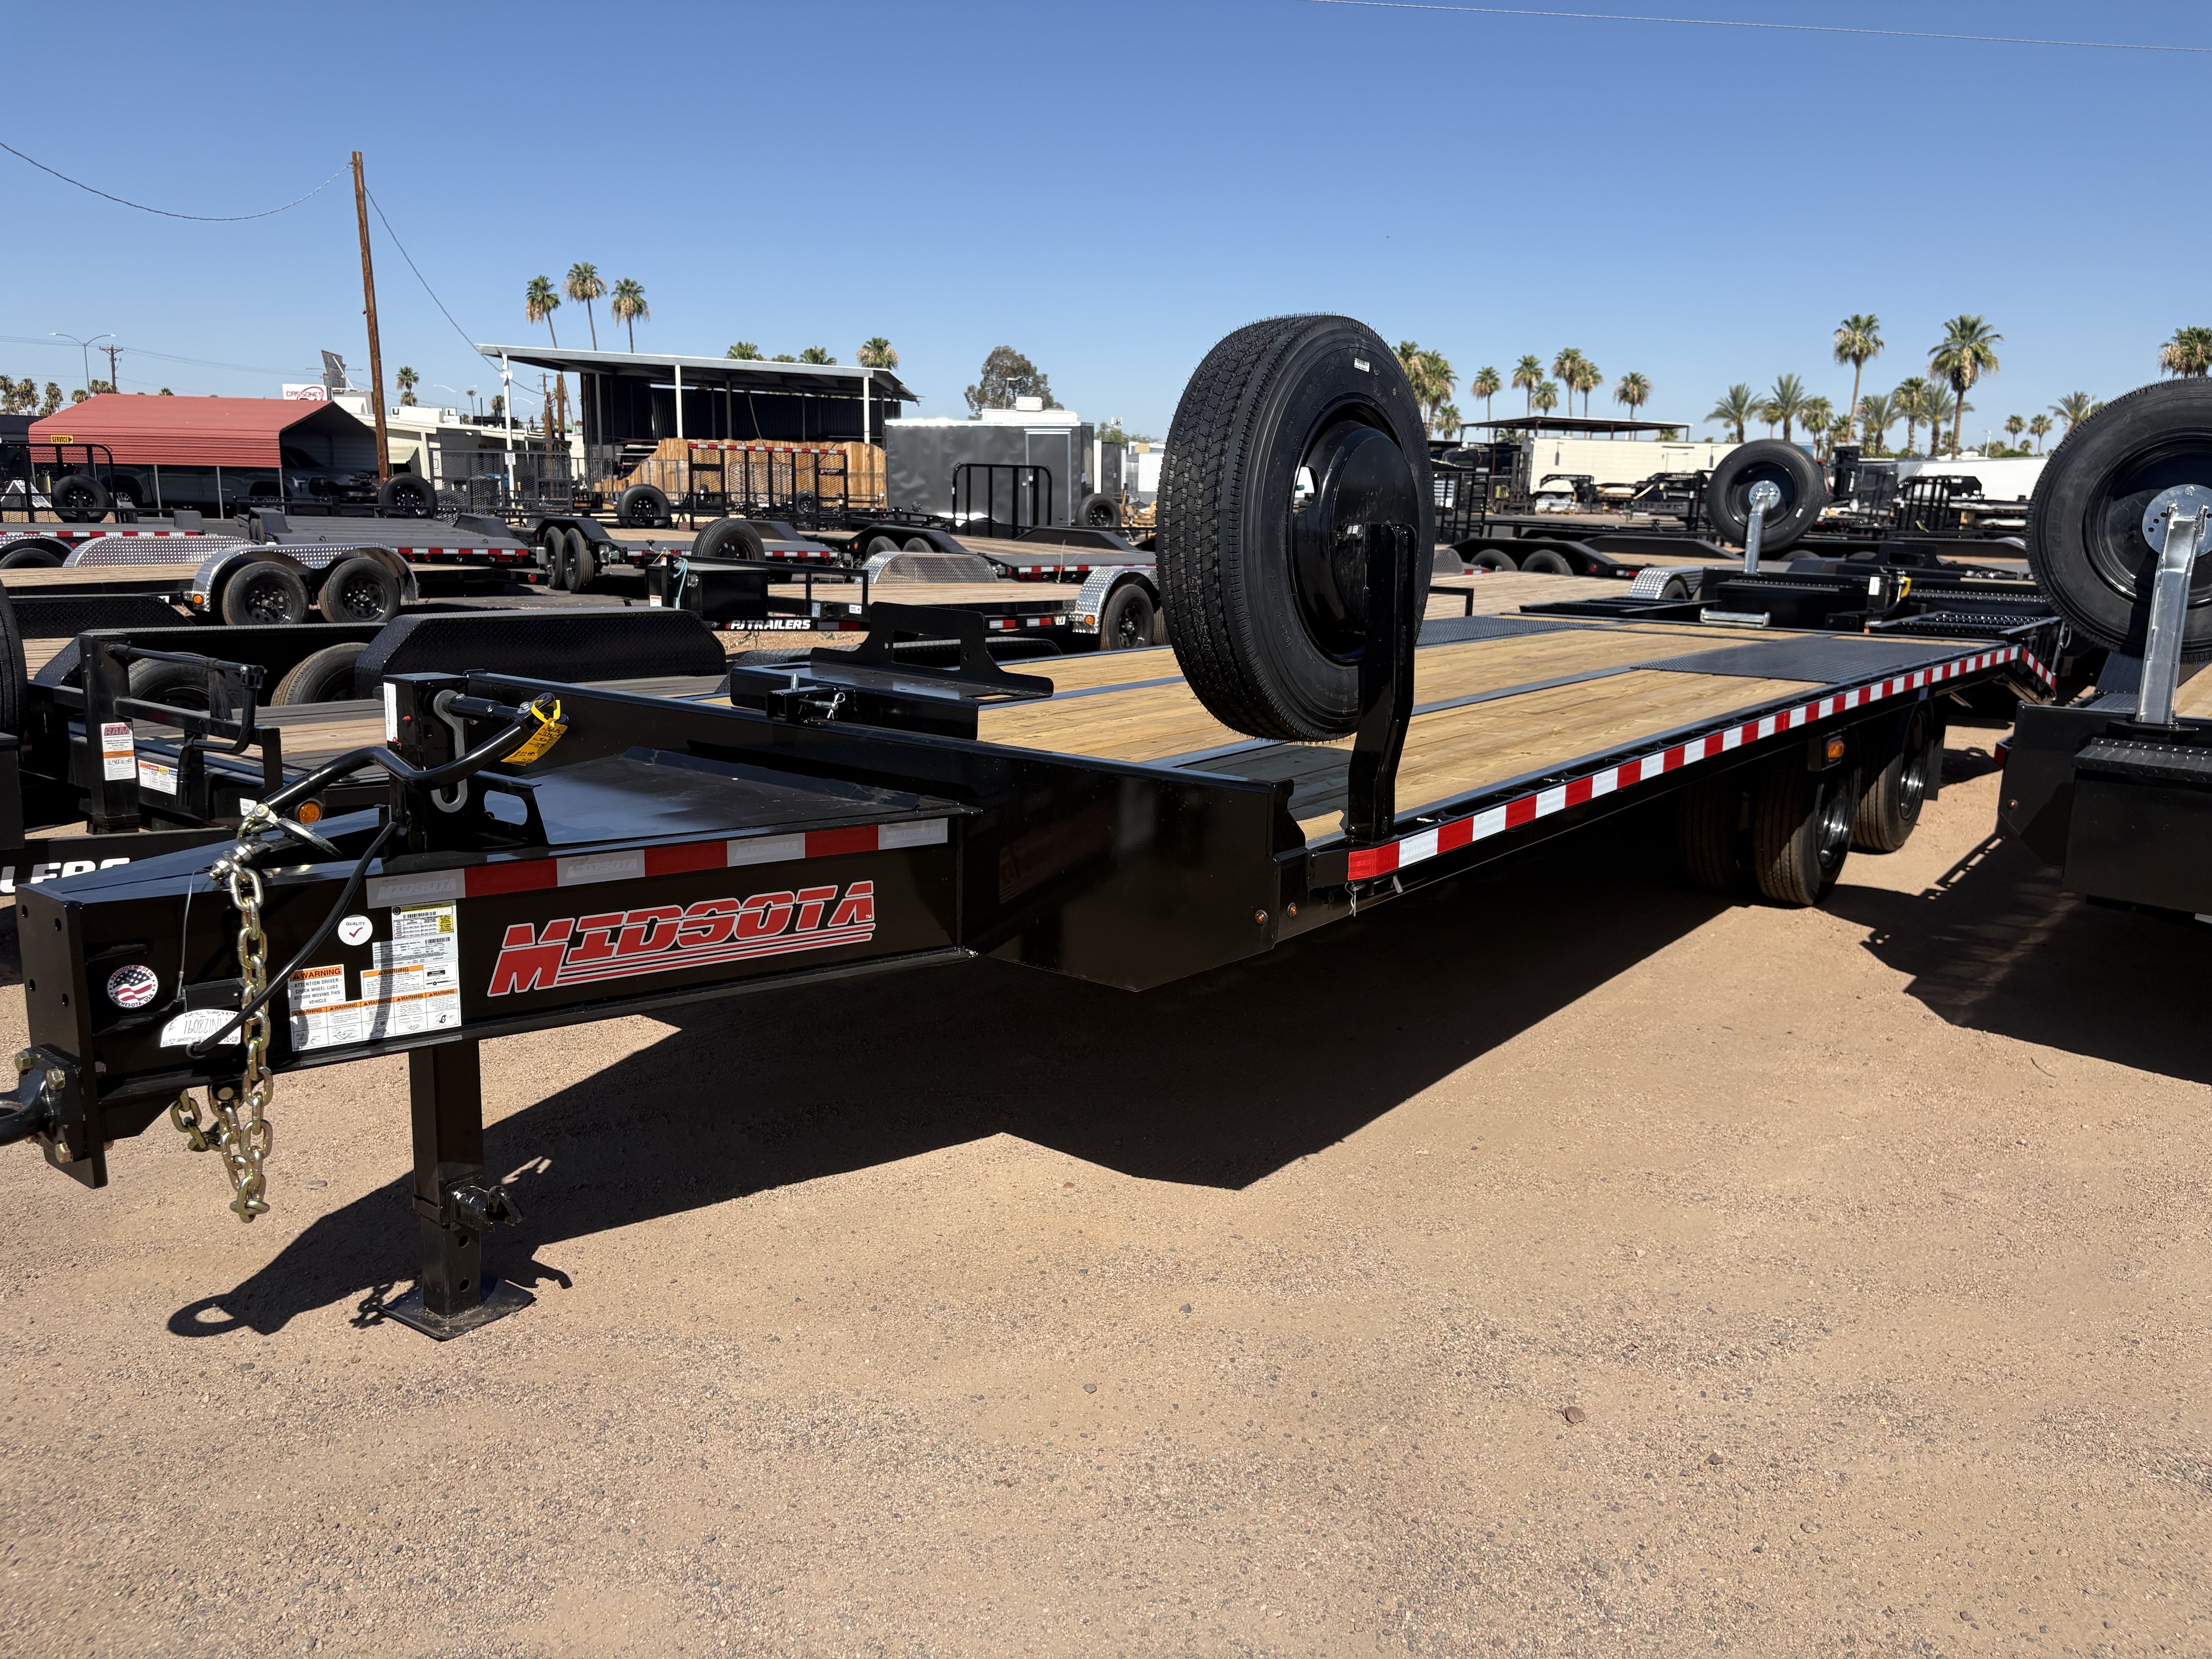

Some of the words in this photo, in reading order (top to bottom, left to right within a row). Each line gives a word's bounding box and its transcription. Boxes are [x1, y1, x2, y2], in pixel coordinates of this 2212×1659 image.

[730, 620, 745, 630] PJ
[747, 619, 811, 630] TRAILERS
[105, 727, 129, 736] RAM
[487, 880, 874, 997] MIDSOTA
[111, 965, 132, 981] PROUDLY
[301, 968, 341, 979] WARNING
[144, 994, 154, 1002] USA
